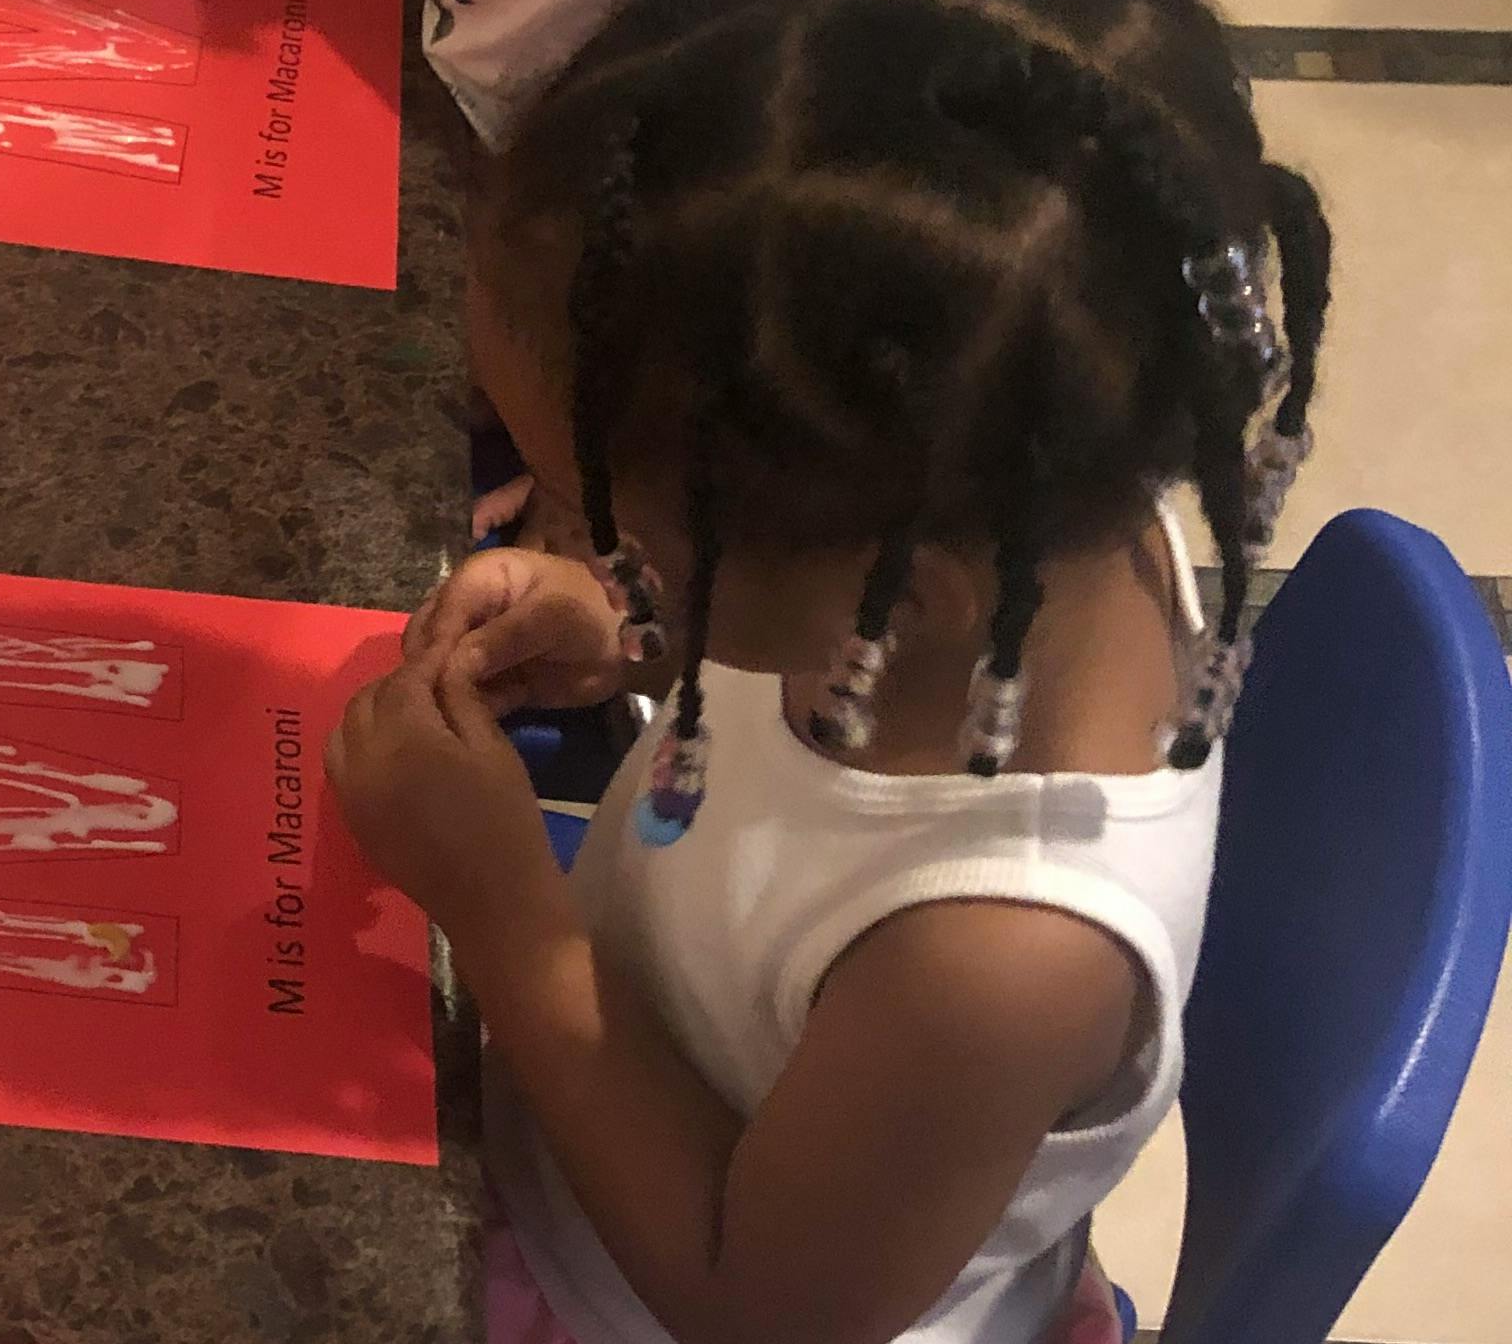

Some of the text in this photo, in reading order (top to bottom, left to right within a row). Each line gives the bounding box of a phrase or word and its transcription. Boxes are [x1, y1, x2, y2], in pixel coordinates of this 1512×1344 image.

[258, 108, 293, 144] for
[254, 148, 288, 169] is
[252, 172, 285, 200] M
[262, 706, 306, 1015] M is for Macaroni
